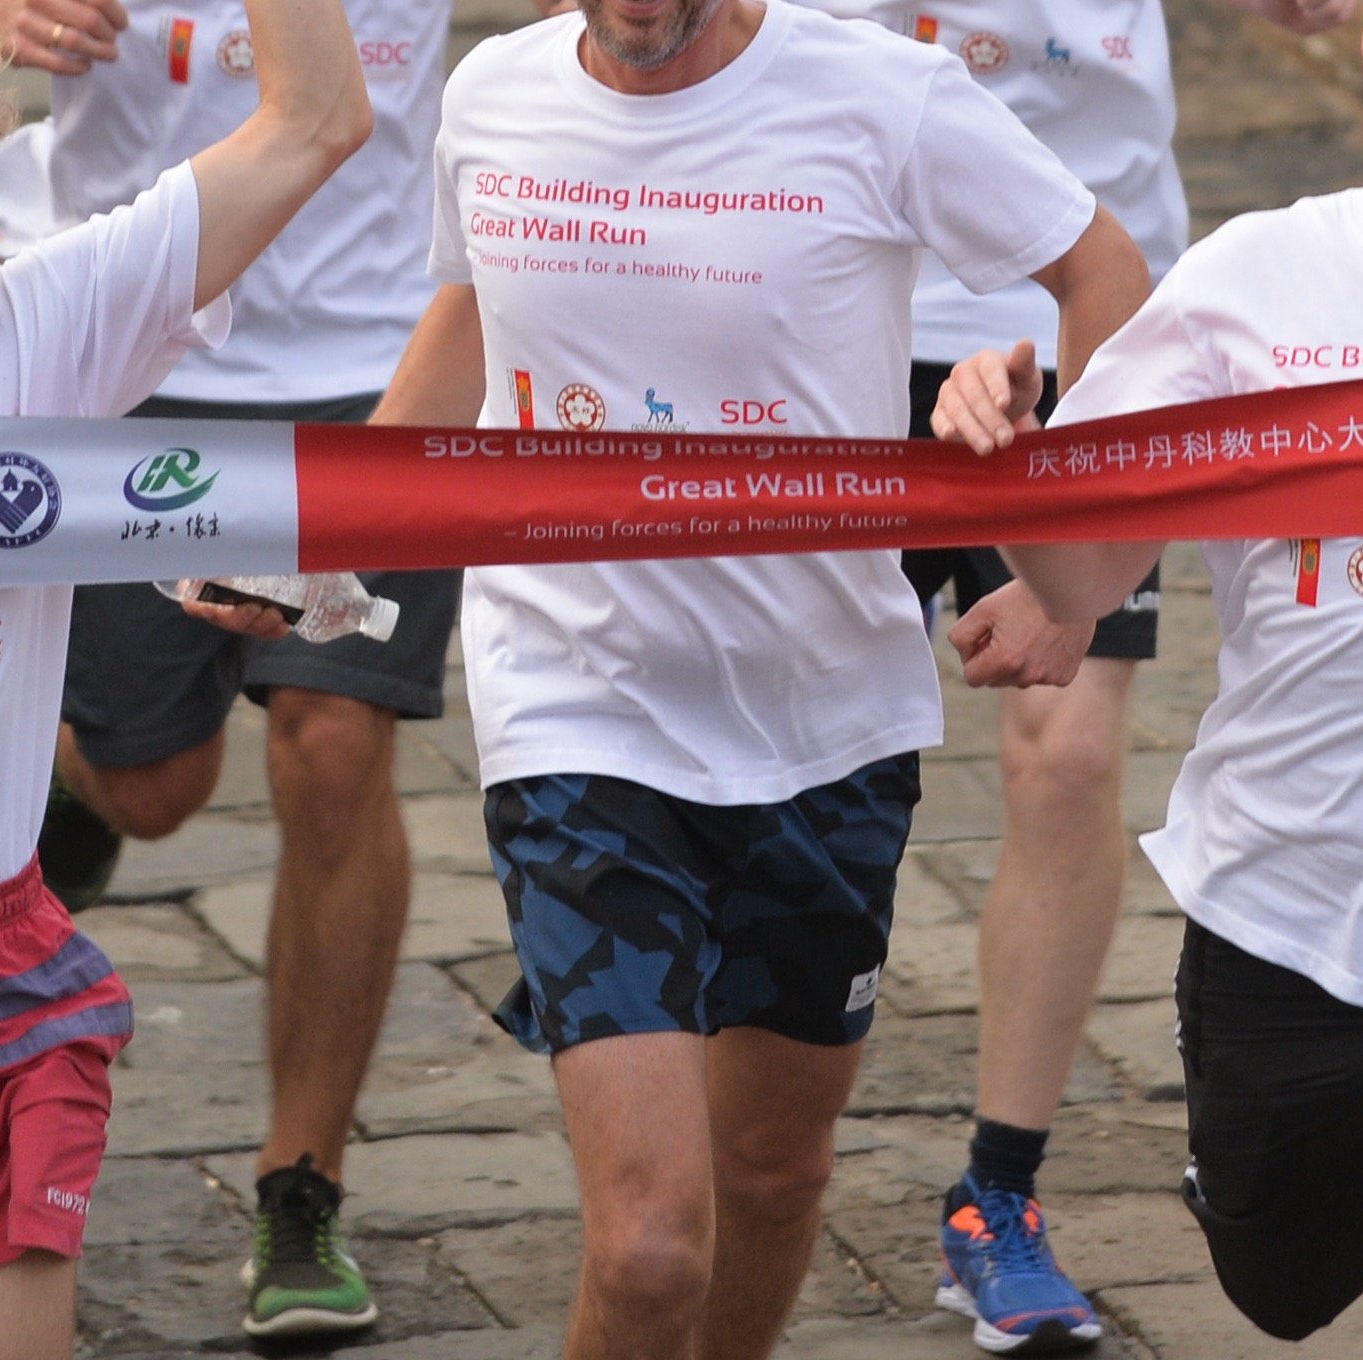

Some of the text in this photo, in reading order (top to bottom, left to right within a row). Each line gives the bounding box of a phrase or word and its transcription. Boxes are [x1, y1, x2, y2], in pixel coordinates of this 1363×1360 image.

[359, 42, 411, 66] SDC
[475, 172, 825, 214] SDC Building Inauguration
[470, 212, 648, 246] Great Wall Run
[523, 254, 579, 274] forces
[584, 256, 611, 275] for
[616, 262, 627, 276] a
[631, 260, 701, 283] healthy
[705, 264, 764, 285] future
[1271, 344, 1334, 369] SDC
[720, 399, 788, 426] SDC
[423, 435, 905, 463] SDC Building Inauguration
[640, 471, 906, 501] Great Wall Run
[524, 520, 604, 541] Joining
[612, 518, 682, 537] forces
[689, 516, 721, 535] for
[727, 520, 740, 533] a
[748, 513, 833, 533] healthy
[840, 511, 909, 529] future
